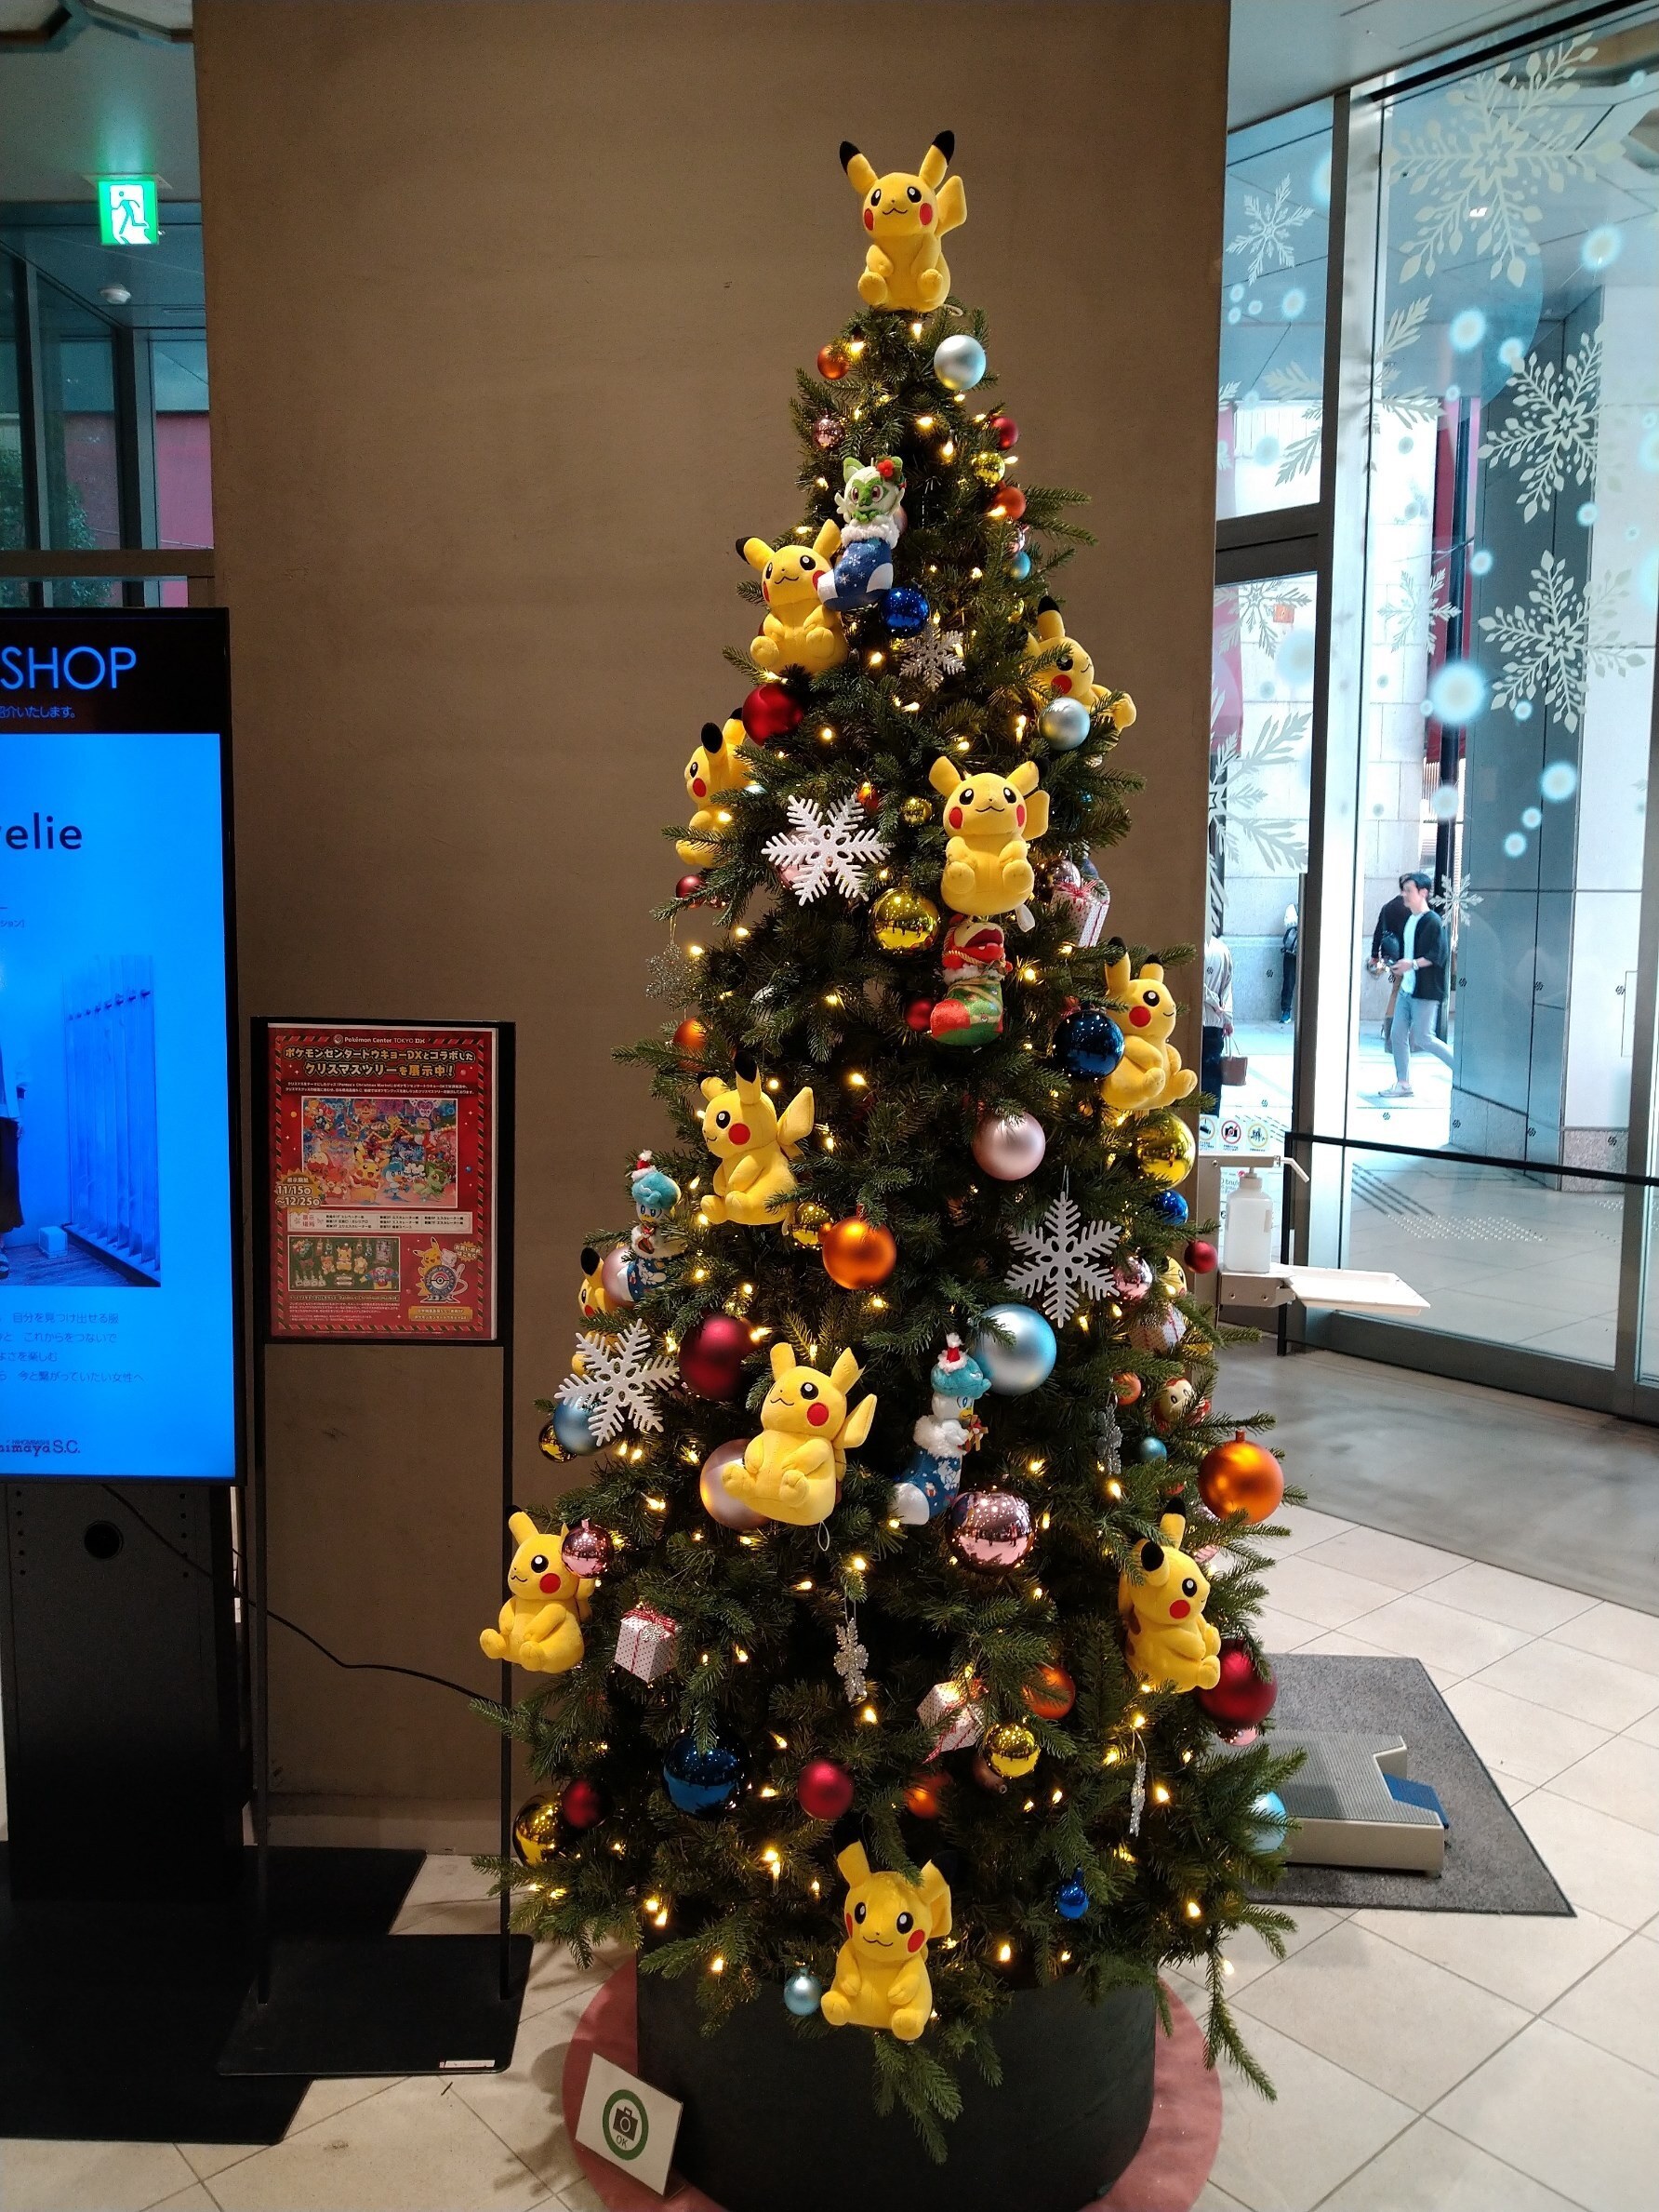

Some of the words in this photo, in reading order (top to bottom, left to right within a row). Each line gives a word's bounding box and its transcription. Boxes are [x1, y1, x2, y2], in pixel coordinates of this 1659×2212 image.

[0, 646, 137, 689] SHOP
[0, 812, 83, 849] elie
[285, 1047, 474, 1061] ポケモンセンタートウキョーDXとコラボした
[53, 1439, 81, 1454] S.C.
[616, 2134, 628, 2149] OK
